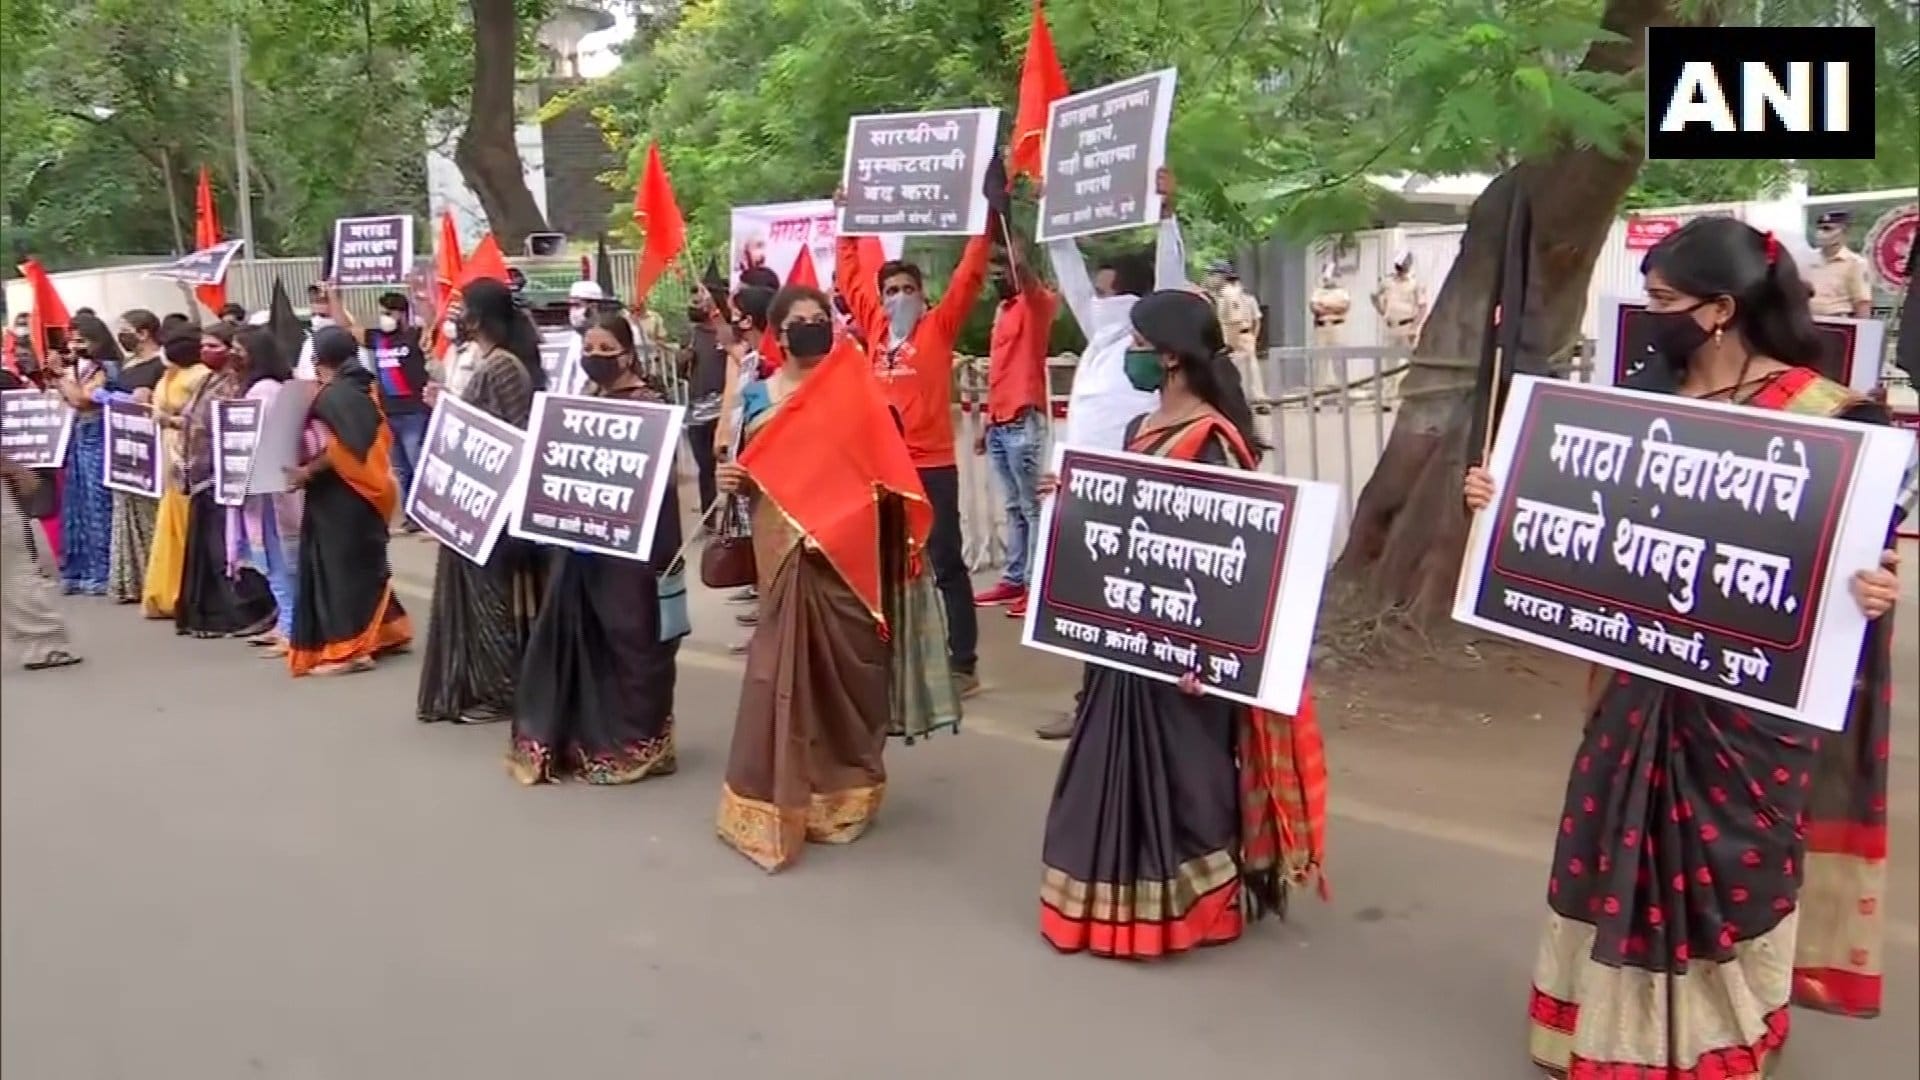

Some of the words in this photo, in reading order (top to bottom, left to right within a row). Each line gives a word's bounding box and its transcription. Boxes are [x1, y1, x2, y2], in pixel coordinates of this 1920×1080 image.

[864, 180, 895, 203] बंद
[463, 425, 513, 475] मराठा
[562, 408, 643, 441] मराठा
[1550, 423, 1632, 485] मराठा
[542, 440, 650, 480] आरक्षण
[450, 470, 498, 522] मराठा
[541, 474, 634, 514] वाचवा
[1069, 468, 1127, 505] मराठा
[1133, 478, 1285, 535] आरक्षणाबाबत
[1083, 520, 1122, 561] एक
[1127, 516, 1247, 585] दिवसाचाही
[1512, 491, 1606, 565] दाखले
[1612, 503, 1707, 615] थांबवु
[1711, 542, 1798, 615] नका.
[1103, 566, 1145, 614] खंड
[1150, 579, 1203, 627] नको.
[1055, 617, 1101, 644] मराठा
[1104, 628, 1149, 655] क्रांती
[1153, 637, 1203, 673] मोर्चा,
[1208, 653, 1241, 683] पुणे
[1504, 588, 1563, 625] मराठा
[1569, 607, 1630, 644] क्रांती
[1637, 621, 1711, 672] मोर्चा,
[1718, 647, 1770, 685] पुणे
